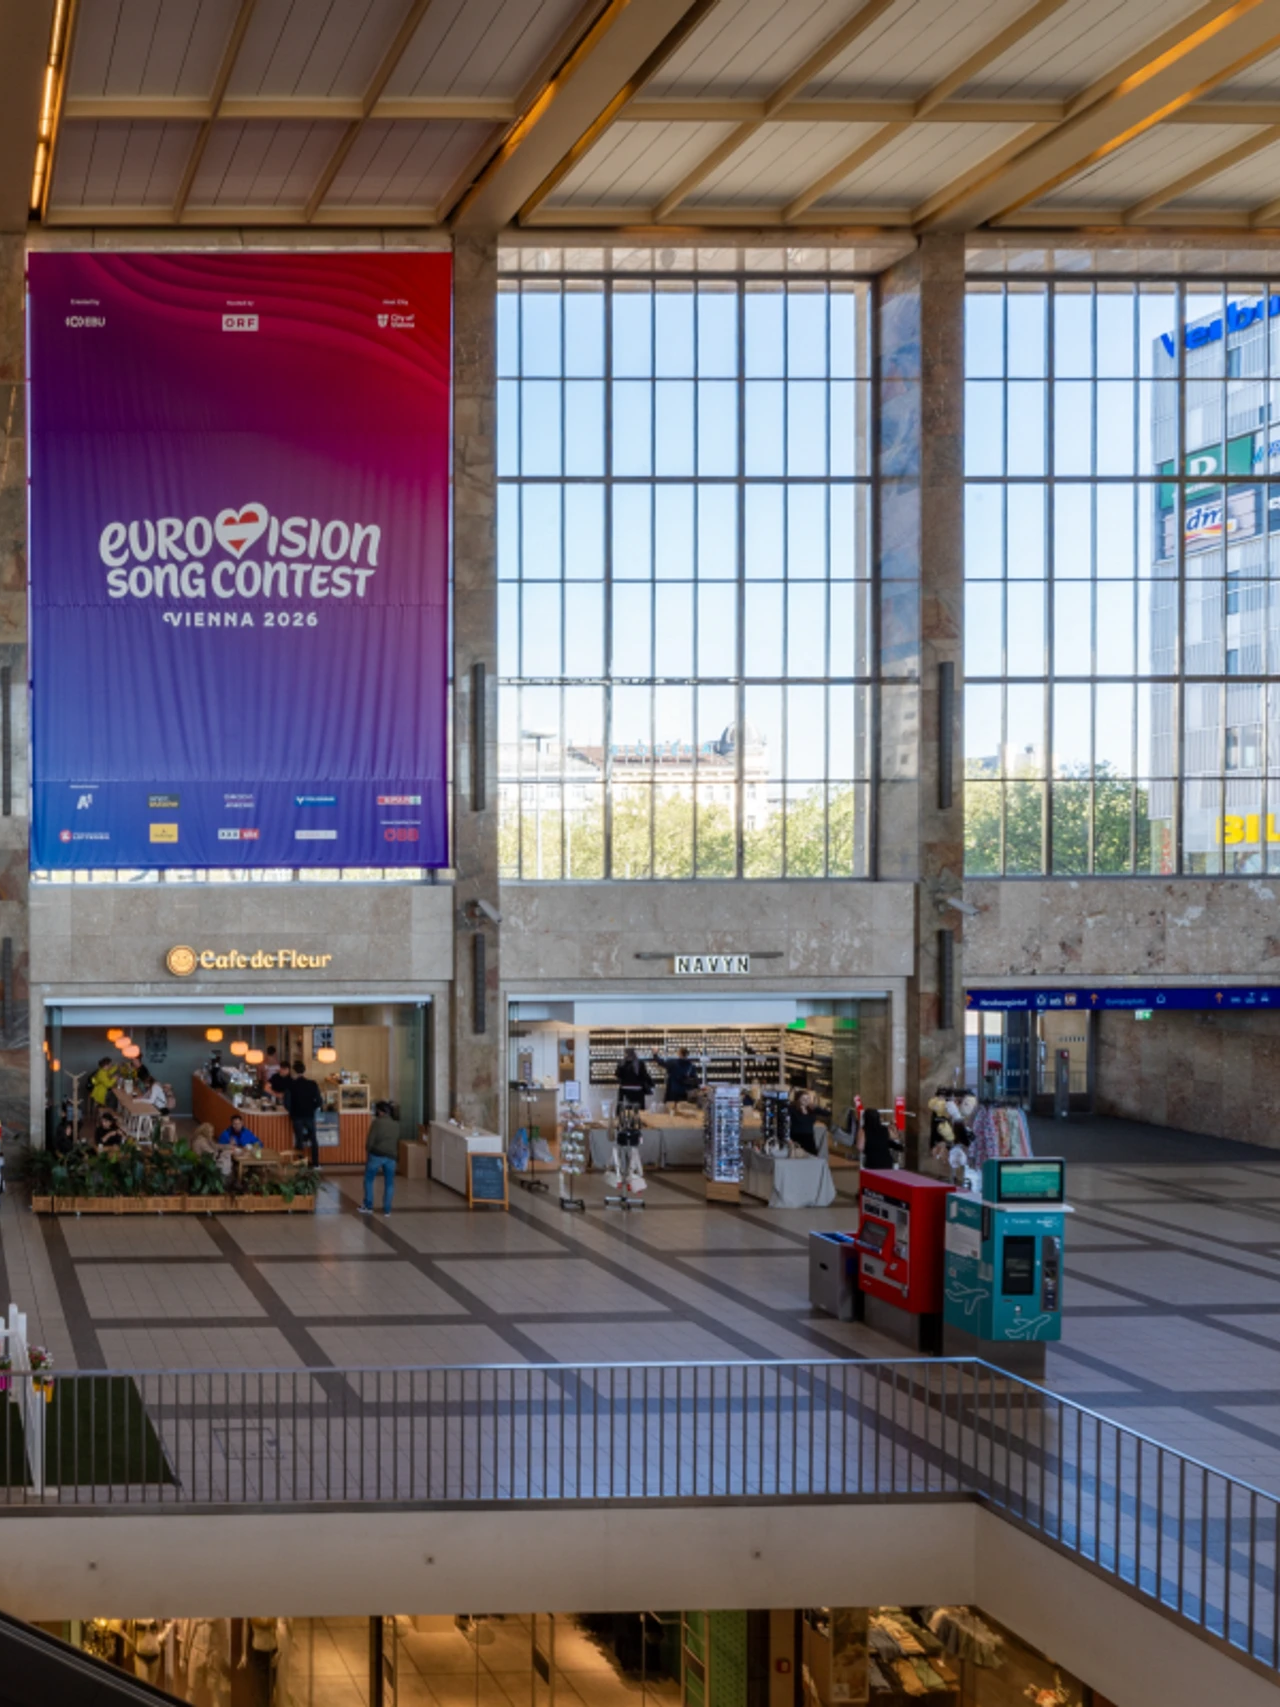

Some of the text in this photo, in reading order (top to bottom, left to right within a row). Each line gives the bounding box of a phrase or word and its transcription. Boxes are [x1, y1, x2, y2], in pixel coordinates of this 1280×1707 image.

[224, 317, 256, 328] ORF
[162, 612, 319, 628] VIENNA 2026
[200, 949, 332, 969] Cafe de Fleur
[677, 957, 749, 973] NAVYN
